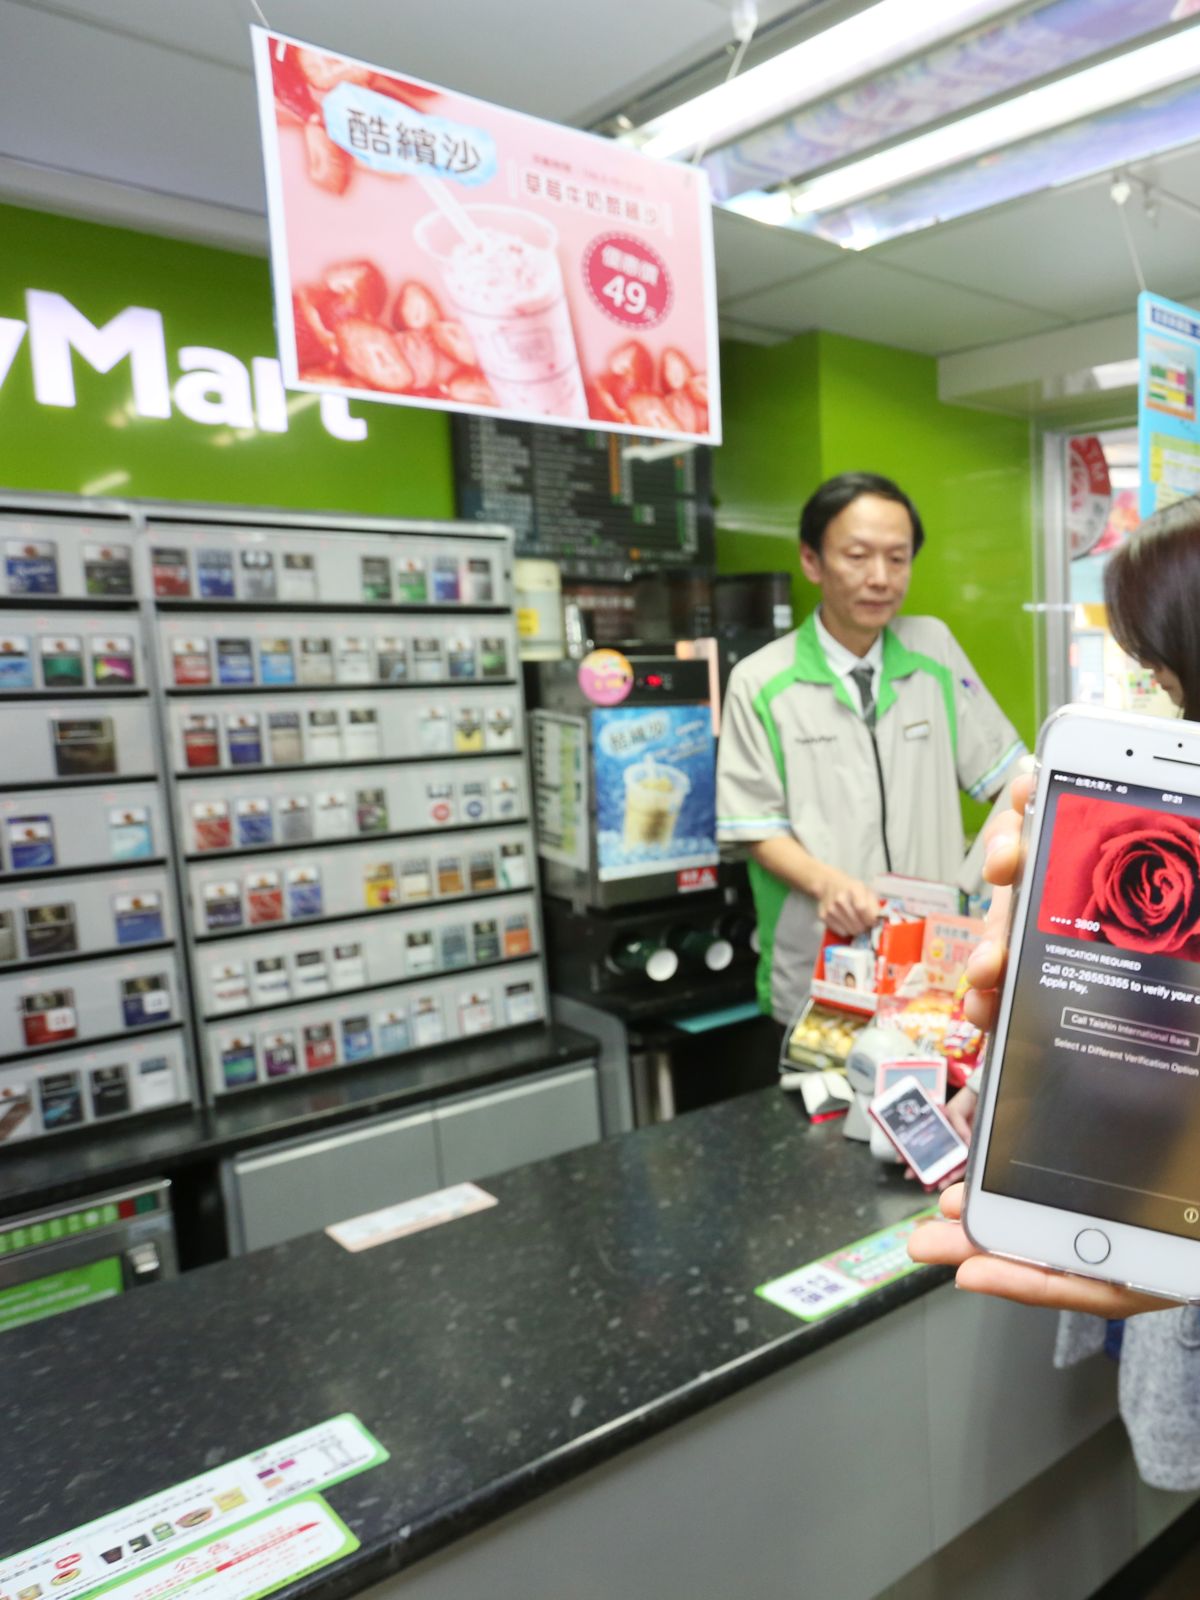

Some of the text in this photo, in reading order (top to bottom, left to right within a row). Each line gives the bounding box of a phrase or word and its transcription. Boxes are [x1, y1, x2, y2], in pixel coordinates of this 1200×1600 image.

[347, 108, 480, 173] 酷繽沙
[1045, 944, 1142, 971] VERIFICATION REQUIRED
[1040, 975, 1088, 995] Apple Pay.
[1042, 962, 1061, 975] Call
[1130, 980, 1141, 992] to
[1142, 984, 1170, 999] verify
[1170, 990, 1194, 1003] your
[1071, 1014, 1190, 1047] Call Taishin International Bank
[1054, 1037, 1080, 1051] Select
[1087, 1045, 1123, 1061] Different
[1124, 1052, 1170, 1071] Verification
[1170, 1062, 1200, 1077] Option
